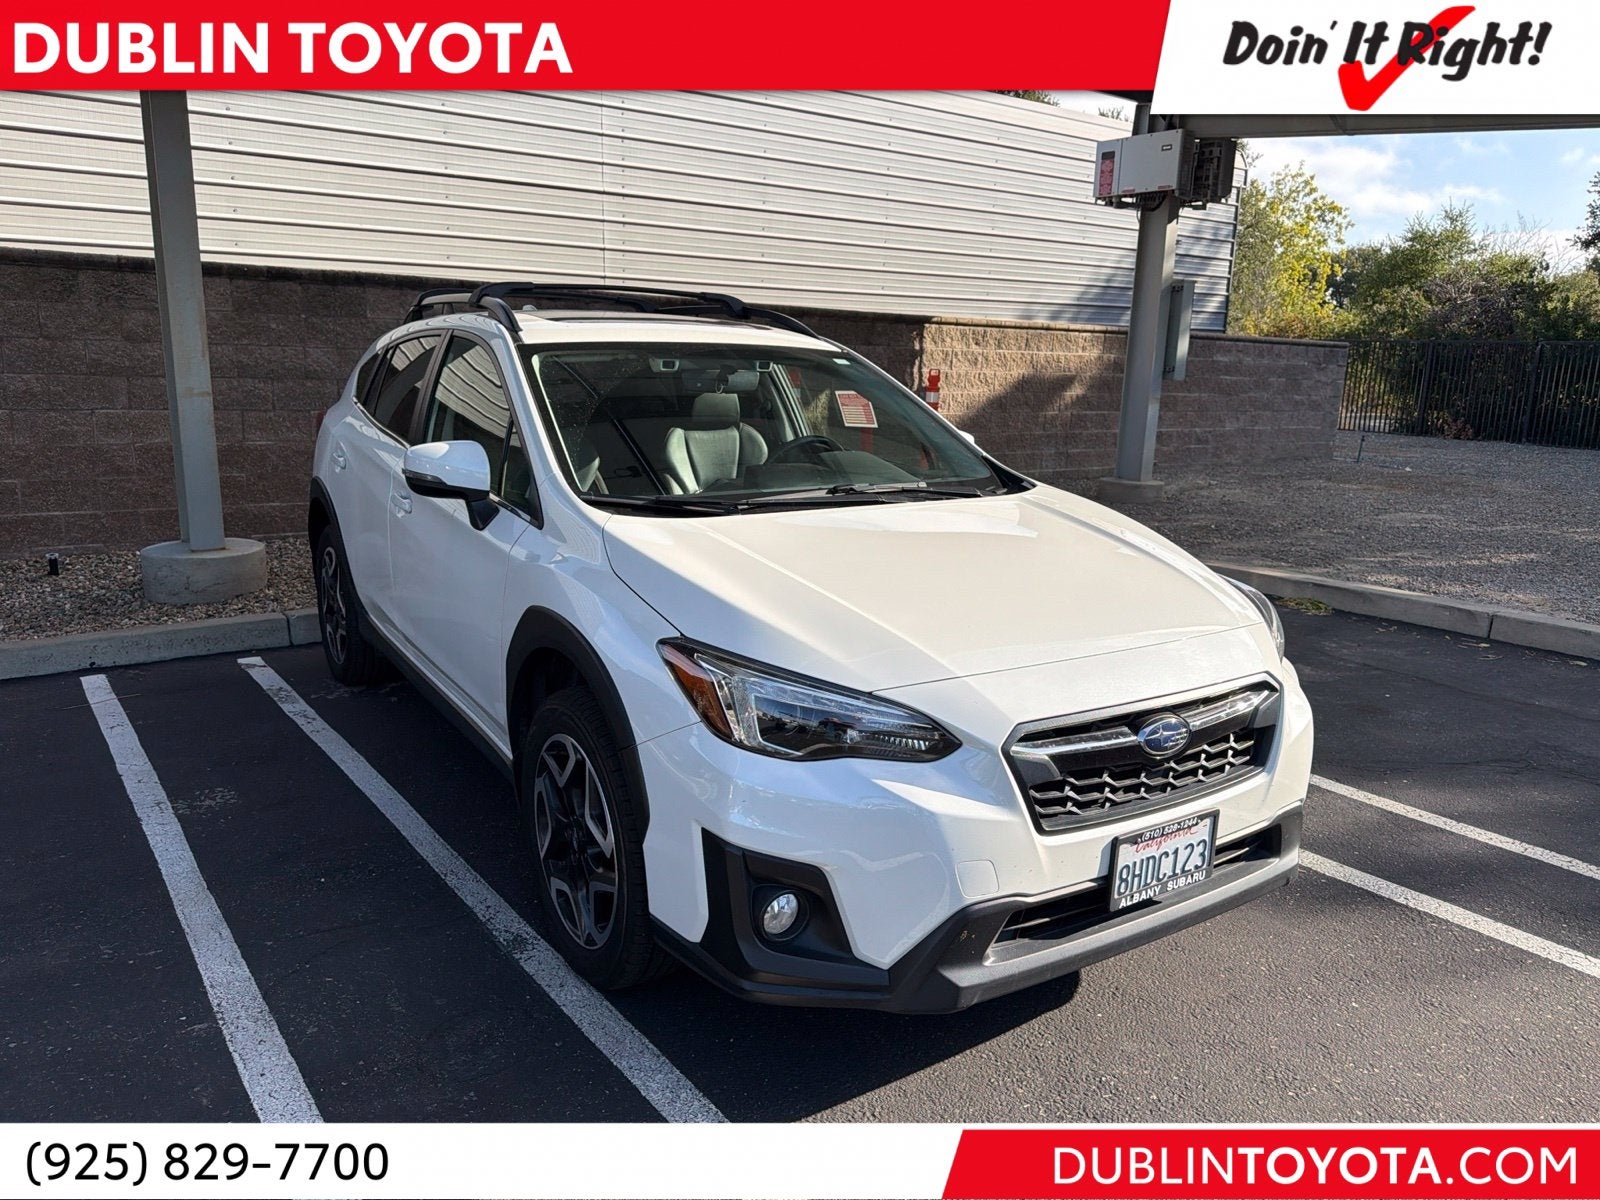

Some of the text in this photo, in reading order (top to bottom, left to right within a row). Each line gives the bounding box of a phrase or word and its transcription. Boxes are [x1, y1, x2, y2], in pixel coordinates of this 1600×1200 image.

[1142, 828, 1163, 841] (510)
[1117, 839, 1207, 896] 8HDC123
[1119, 870, 1206, 909] ALBANY SUBARU
